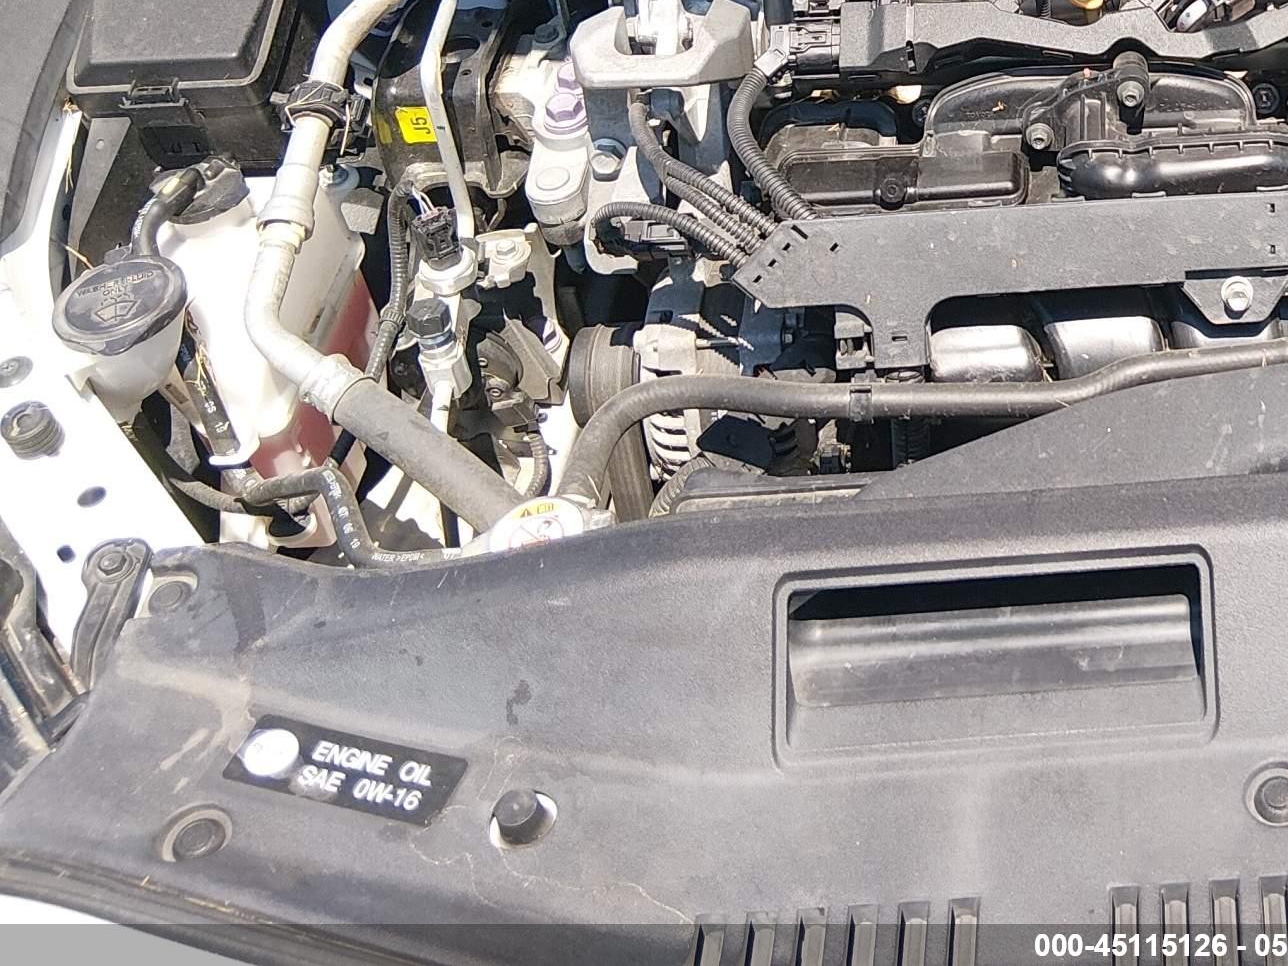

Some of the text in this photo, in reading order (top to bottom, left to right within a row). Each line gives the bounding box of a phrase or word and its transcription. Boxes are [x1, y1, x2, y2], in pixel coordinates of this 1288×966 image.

[102, 284, 128, 297] ONLY
[311, 740, 393, 776] ENGINE
[398, 760, 433, 787] OIL
[297, 764, 422, 811] SAE 0W-16
